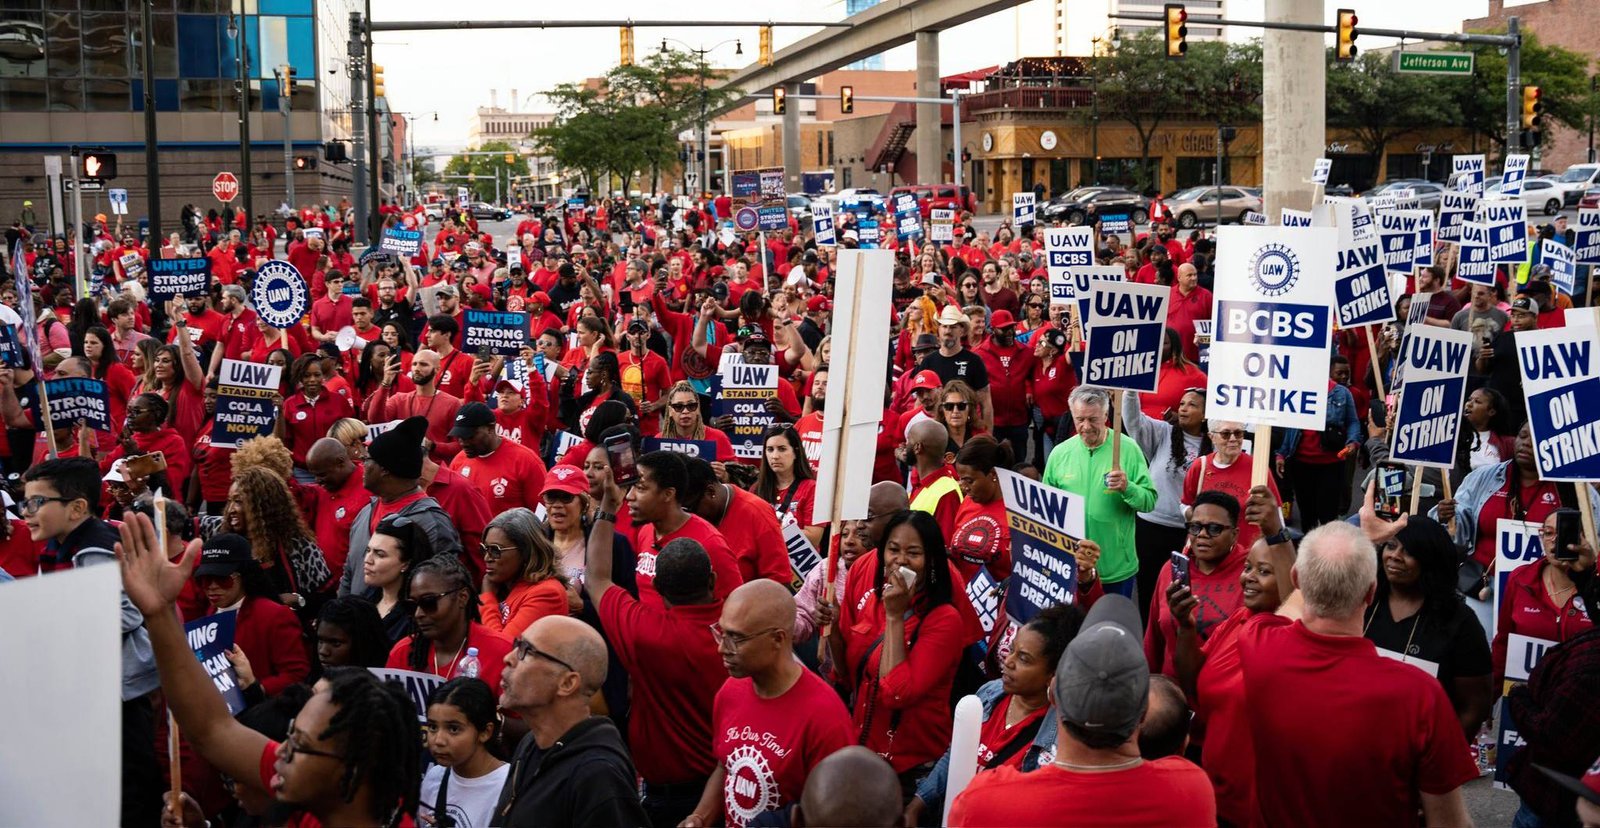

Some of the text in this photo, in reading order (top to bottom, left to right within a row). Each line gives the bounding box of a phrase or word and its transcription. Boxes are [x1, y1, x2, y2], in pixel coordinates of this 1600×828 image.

[1402, 55, 1469, 69] Jefferson Ave
[1455, 159, 1482, 171] UAW
[1507, 158, 1526, 168] UAW
[214, 181, 236, 193] STOP
[1014, 196, 1033, 205] UAW
[1444, 195, 1476, 210] UAW
[812, 206, 830, 217] UAW
[934, 210, 951, 219] UAW
[1488, 206, 1523, 221] UAW
[1283, 213, 1312, 227] UAW
[1381, 214, 1417, 231] UAW
[1580, 213, 1600, 227] UA
[385, 228, 420, 239] UNITED
[1439, 224, 1461, 239] STRI
[1463, 226, 1488, 244] UA
[1500, 225, 1514, 241] ON
[381, 243, 418, 252] CONTRACT
[383, 238, 419, 247] STRONG
[1051, 234, 1089, 248] UAW
[1389, 236, 1405, 251] ON
[1384, 248, 1413, 265] TRIKE
[1470, 248, 1485, 262] ON
[1491, 238, 1525, 261] STRIKE
[1544, 243, 1575, 262] UAW
[1576, 245, 1600, 261] STRI
[151, 258, 207, 272] UNITED
[1054, 253, 1088, 265] BCBS
[1553, 260, 1565, 272] ON
[1062, 271, 1071, 281] O
[1263, 264, 1284, 276] UAW
[1459, 261, 1493, 276] STRIKE
[153, 272, 206, 285] STRONG
[1350, 273, 1371, 298] ON
[153, 282, 207, 293] CONTRACT
[267, 287, 290, 303] UAW
[1053, 285, 1075, 297] STR
[1094, 290, 1164, 321] UAW
[1340, 286, 1389, 323] STRIKE
[468, 311, 524, 325] UNITED
[1228, 308, 1315, 340] BCBS
[467, 326, 524, 340] STRONG
[466, 337, 525, 349] CONTRACT
[1111, 328, 1139, 354] ON
[1411, 336, 1468, 375] UAW
[1520, 340, 1592, 381] UAW
[230, 362, 272, 385] UAW
[1089, 351, 1156, 382] STRIKE
[1243, 352, 1291, 380] ON
[732, 366, 770, 386] UAW
[221, 387, 257, 397] STAND
[1215, 383, 1318, 416] STRIKE
[228, 401, 263, 413] COLA
[733, 403, 766, 413] COLA
[1419, 384, 1445, 418] ON
[1548, 390, 1579, 431] ON
[216, 412, 272, 426] FAIR PAY
[752, 416, 775, 426] PAY
[226, 422, 258, 434] NOW
[735, 426, 763, 435] NOW
[1397, 413, 1457, 455] STRIKE
[660, 442, 700, 458] END
[1011, 476, 1069, 529] UAW
[1011, 515, 1057, 544] STAND
[1501, 531, 1546, 562] UA
[1023, 544, 1072, 580] SAVING
[1013, 561, 1074, 605] AMERICAN
[202, 652, 232, 677] ICAN
[740, 726, 760, 742] Our
[759, 732, 792, 759] Time!
[735, 775, 758, 800] UAW
